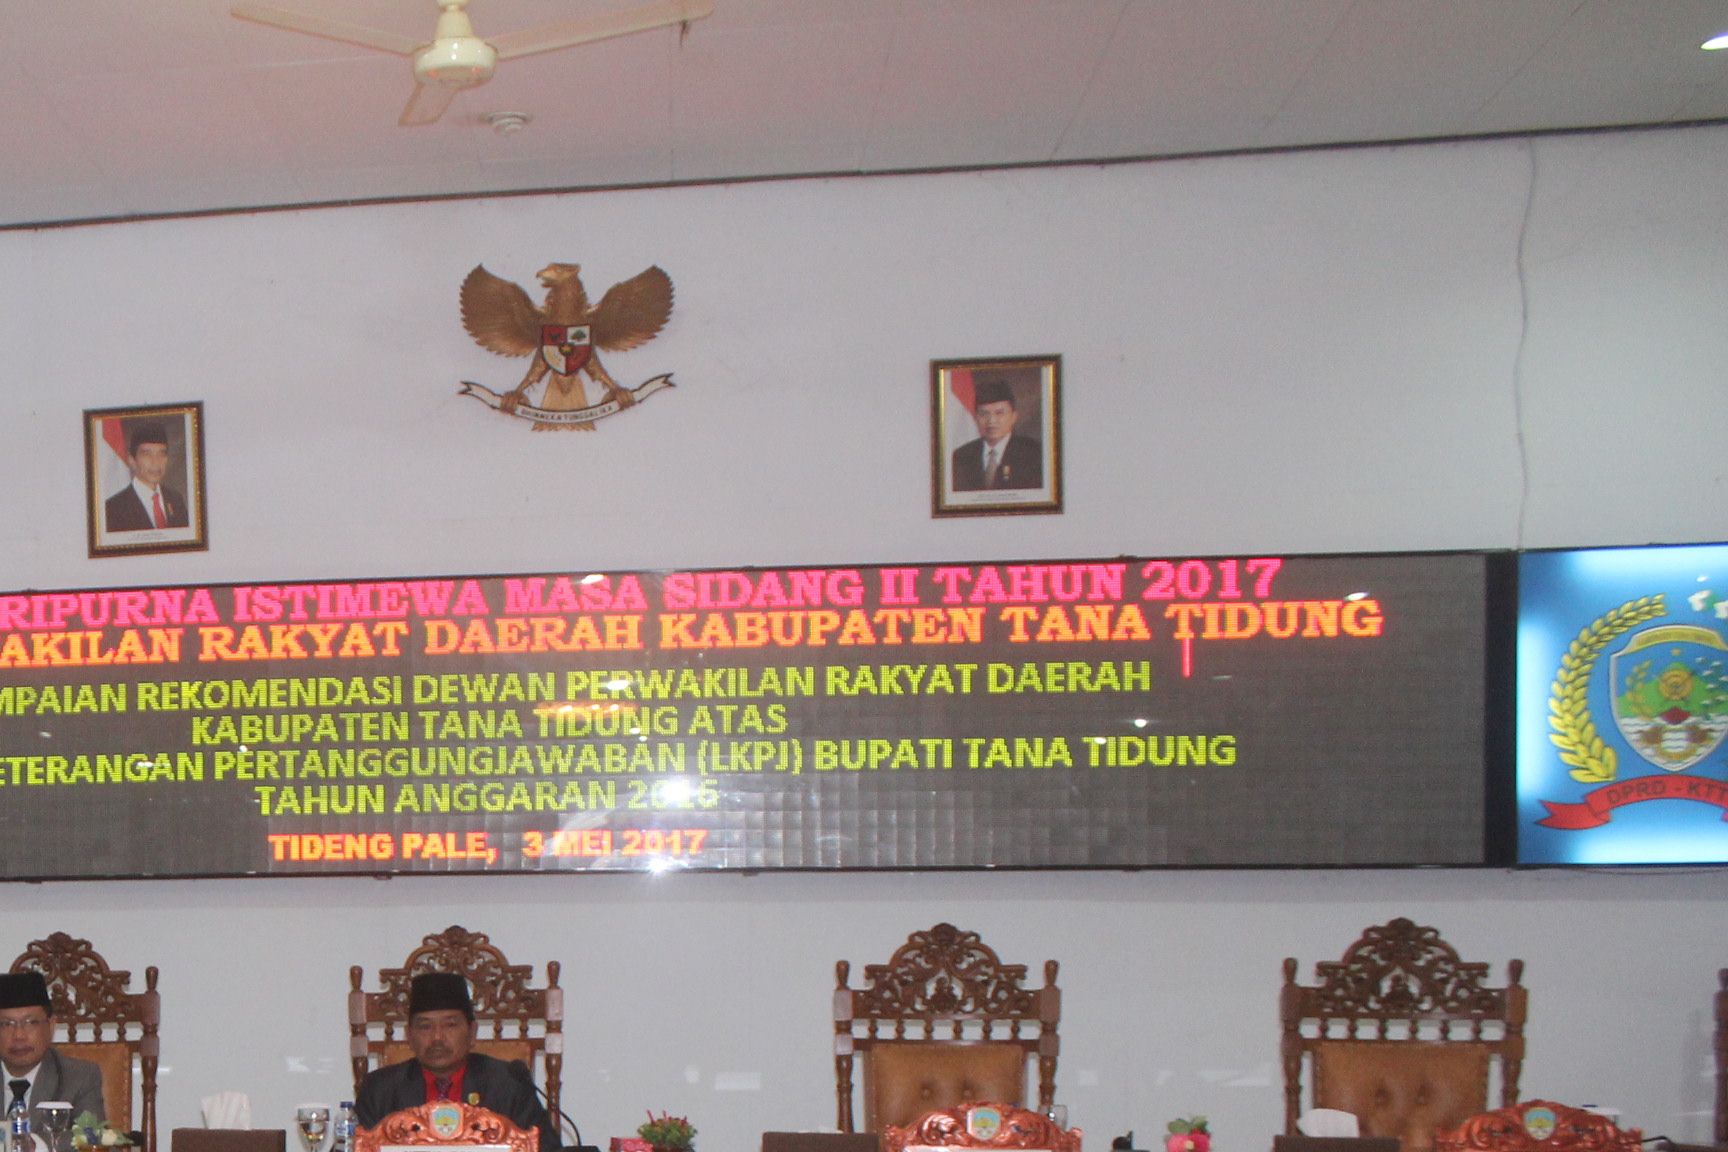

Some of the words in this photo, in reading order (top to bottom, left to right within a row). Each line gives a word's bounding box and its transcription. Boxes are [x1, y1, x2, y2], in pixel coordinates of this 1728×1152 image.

[233, 579, 490, 622] ISTIMEWA
[504, 574, 648, 614] MASA
[662, 569, 865, 610] SIDANG
[879, 568, 920, 604] II
[933, 564, 1127, 604] TAHUN
[1142, 558, 1283, 600] 2017
[198, 620, 409, 661] RAKYAT
[423, 614, 645, 655] DAERAH
[659, 606, 986, 649] KABUPATEN
[1000, 603, 1152, 643] TANA
[1164, 600, 1384, 639] TIDUNG
[136, 675, 403, 711] REKOMENDASI
[412, 672, 556, 705] DEWAN
[566, 666, 815, 700] PERWAKILAN
[825, 663, 978, 696] RAKYAT
[987, 661, 1151, 694] DAERAH
[191, 710, 410, 745] KABUPATEN
[418, 709, 523, 740] TANA
[533, 706, 679, 738] TIDUNG
[688, 704, 789, 735] ATAS
[214, 742, 686, 780] PERTANGGUNGJAWABAN
[696, 738, 804, 776] (LKPJ)
[813, 737, 954, 771] BUPATI
[963, 736, 1073, 768] TANA
[1082, 735, 1237, 767] TIDUNG
[254, 785, 385, 817] TAHUN
[394, 780, 616, 814] ANGGARAN
[1606, 780, 1667, 804] DPRD
[268, 832, 396, 861] TIDENG
[402, 831, 498, 864] PALE,
[521, 830, 546, 858] 3
[553, 829, 613, 857] MEI
[621, 828, 709, 856] 2017
